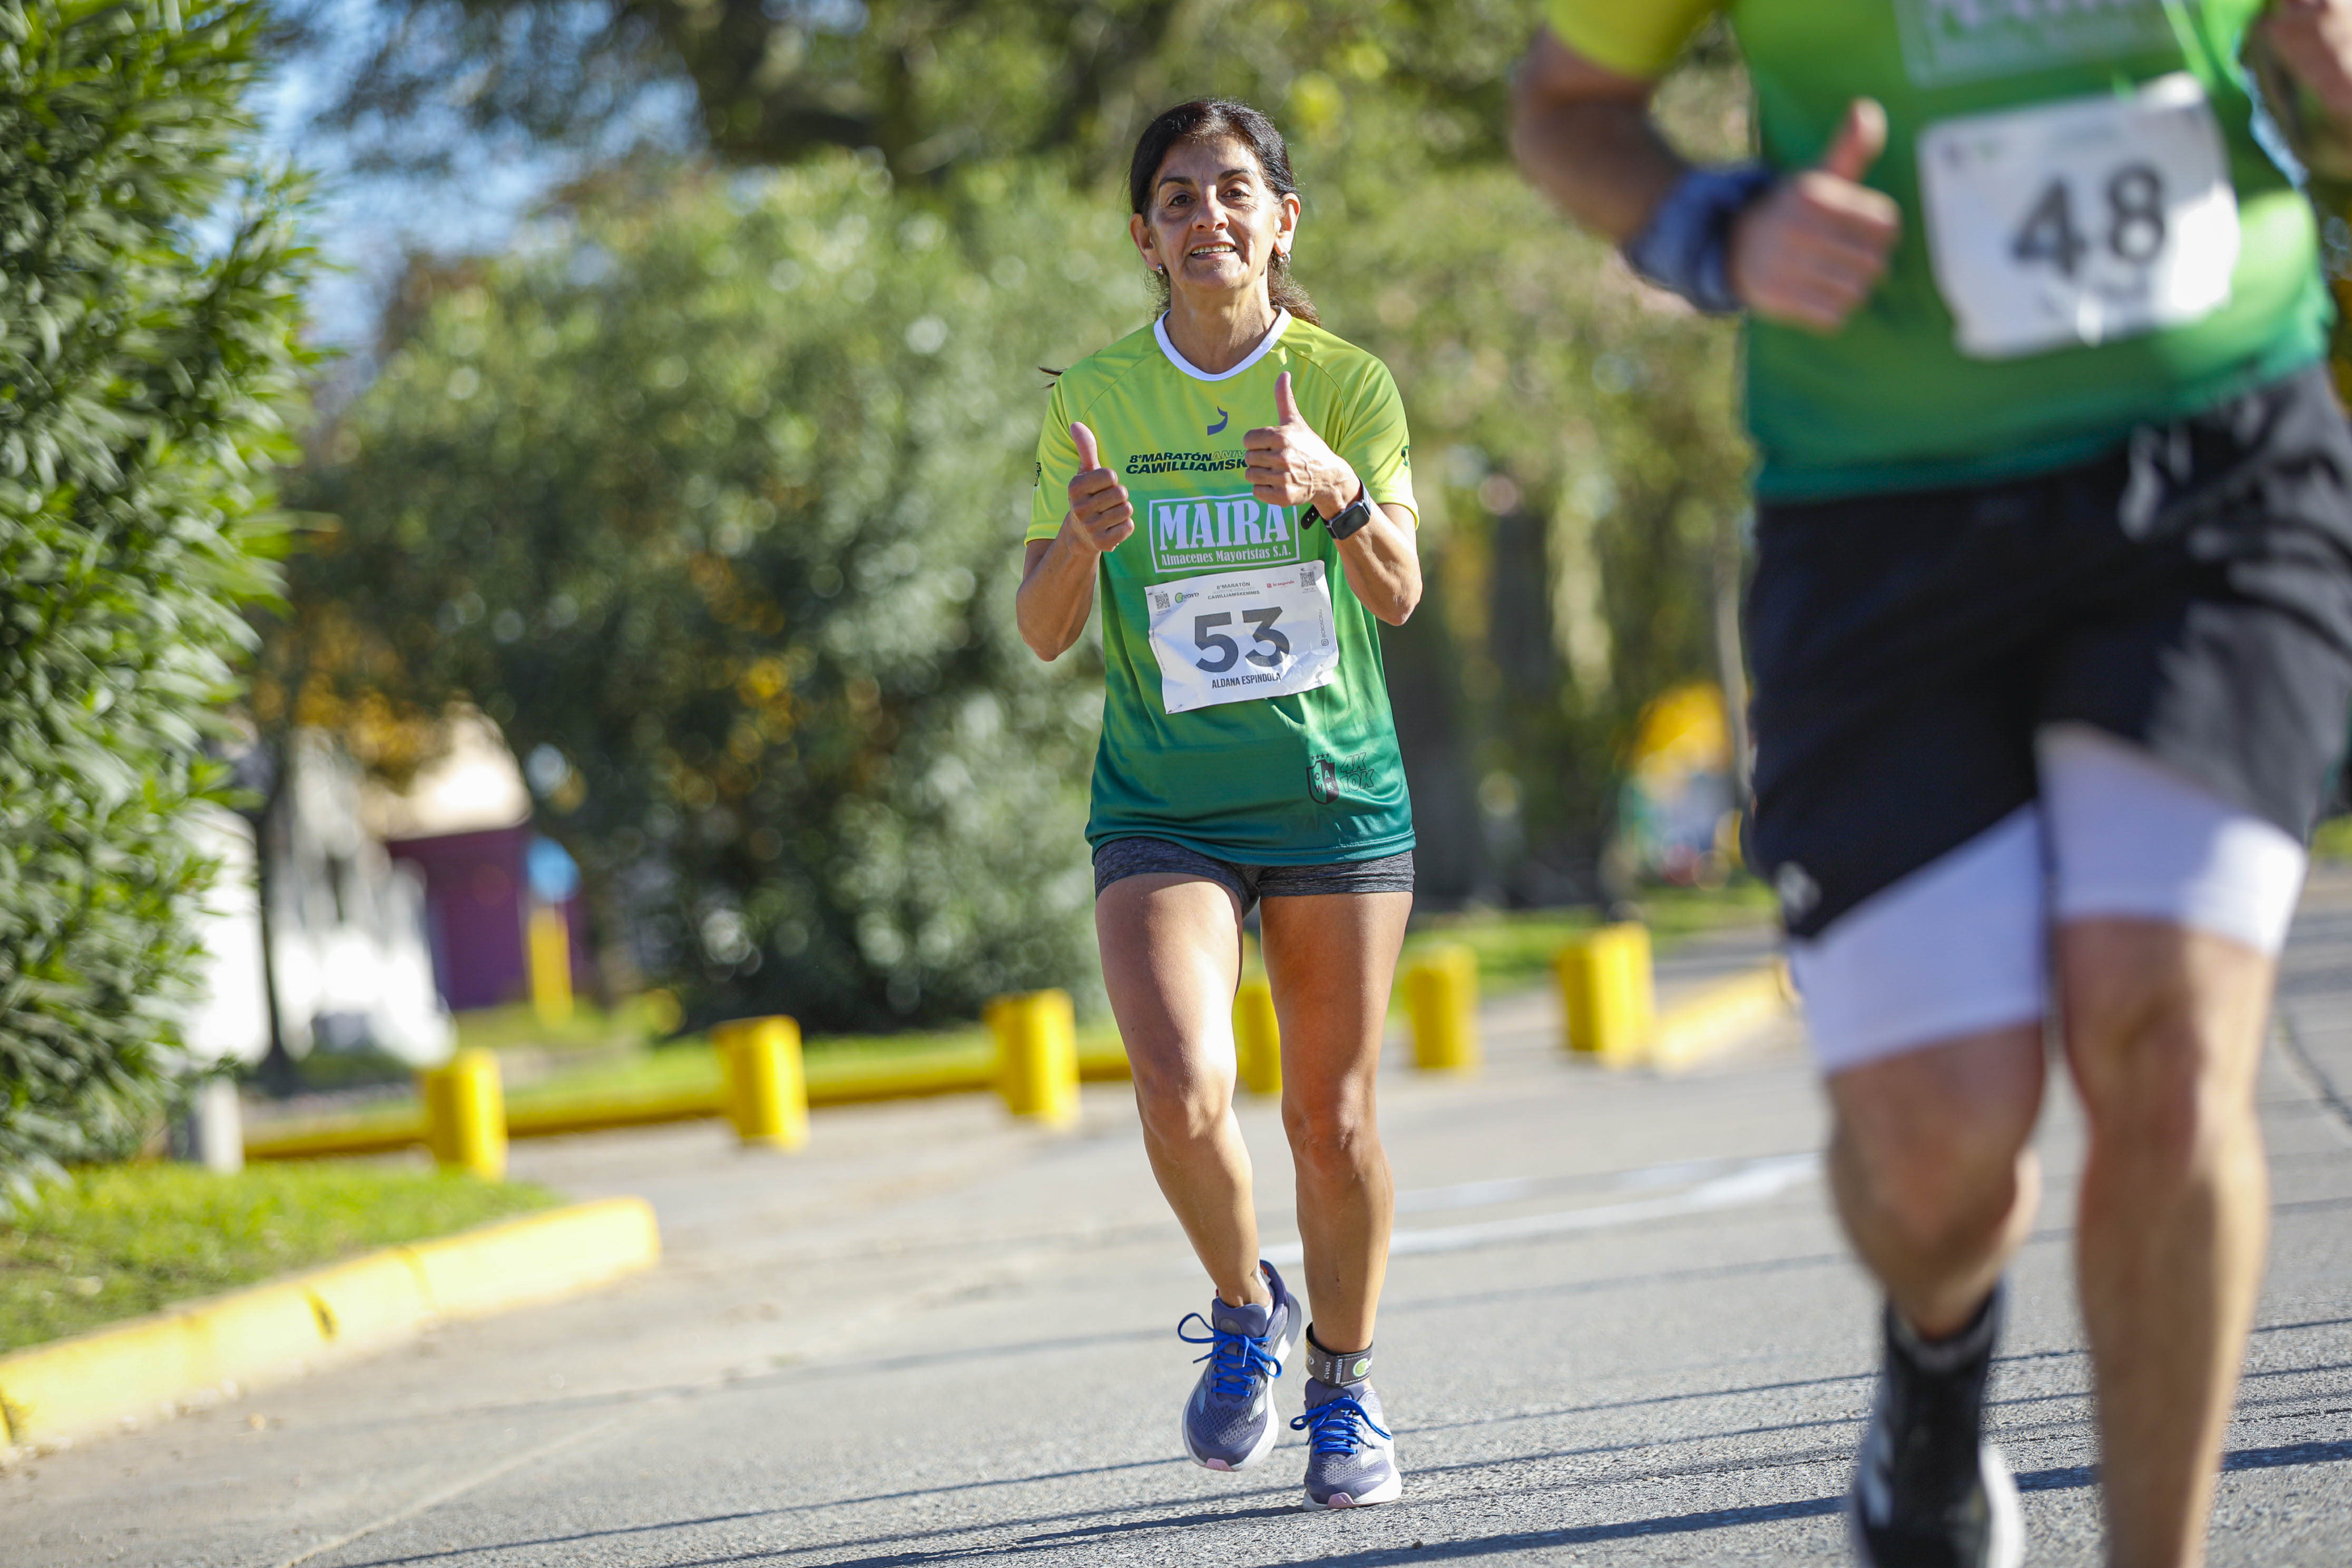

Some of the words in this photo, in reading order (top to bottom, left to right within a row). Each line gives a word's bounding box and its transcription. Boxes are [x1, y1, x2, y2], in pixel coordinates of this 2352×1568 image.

[2008, 162, 2165, 278] 48
[1125, 458, 1248, 474] CAWILLIAMSK
[1158, 499, 1290, 551] MAIRA
[1161, 553, 1214, 566] Almacenes
[1216, 548, 1270, 562] Mayoristas
[1272, 545, 1291, 557] S.A.
[1194, 606, 1290, 673] 53
[1212, 677, 1240, 689] ALDANA
[1241, 672, 1282, 685] ESPINDOLA
[1340, 752, 1367, 774] 4K
[1340, 769, 1374, 792] 10K
